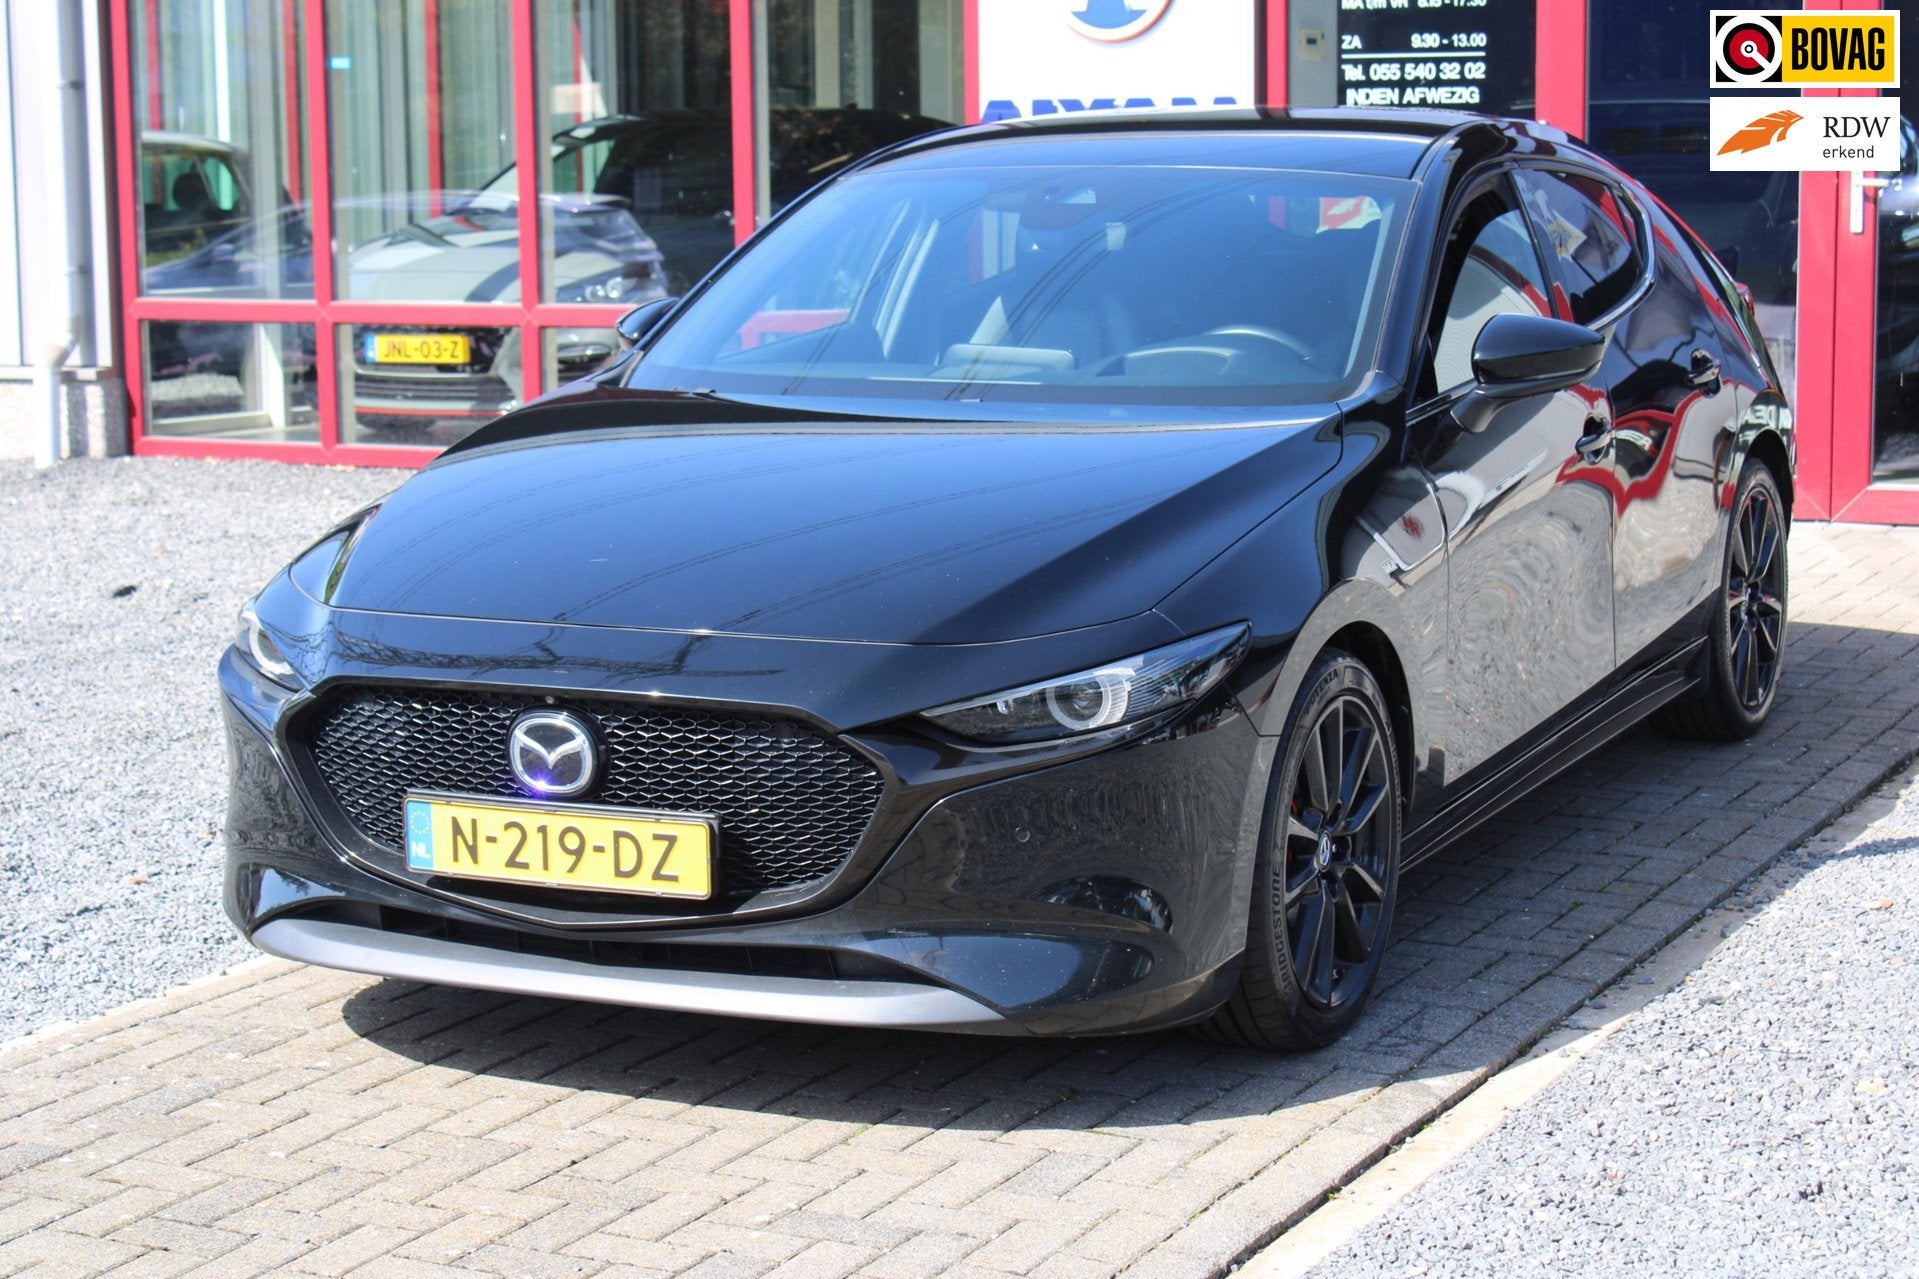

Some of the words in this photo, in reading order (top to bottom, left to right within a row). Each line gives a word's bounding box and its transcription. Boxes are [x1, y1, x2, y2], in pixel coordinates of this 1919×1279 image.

[1341, 34, 1362, 49] ZA
[1411, 33, 1440, 48] 9.30
[1451, 33, 1487, 48] 13.00
[1341, 64, 1366, 81] Tel.
[1369, 62, 1401, 81] 055
[1404, 61, 1436, 81] 540
[1439, 61, 1461, 80] 32
[1464, 61, 1486, 80] 02
[1402, 86, 1480, 105] AFWEZIG
[411, 841, 431, 859] NL
[451, 816, 680, 882] N-219-DZ
